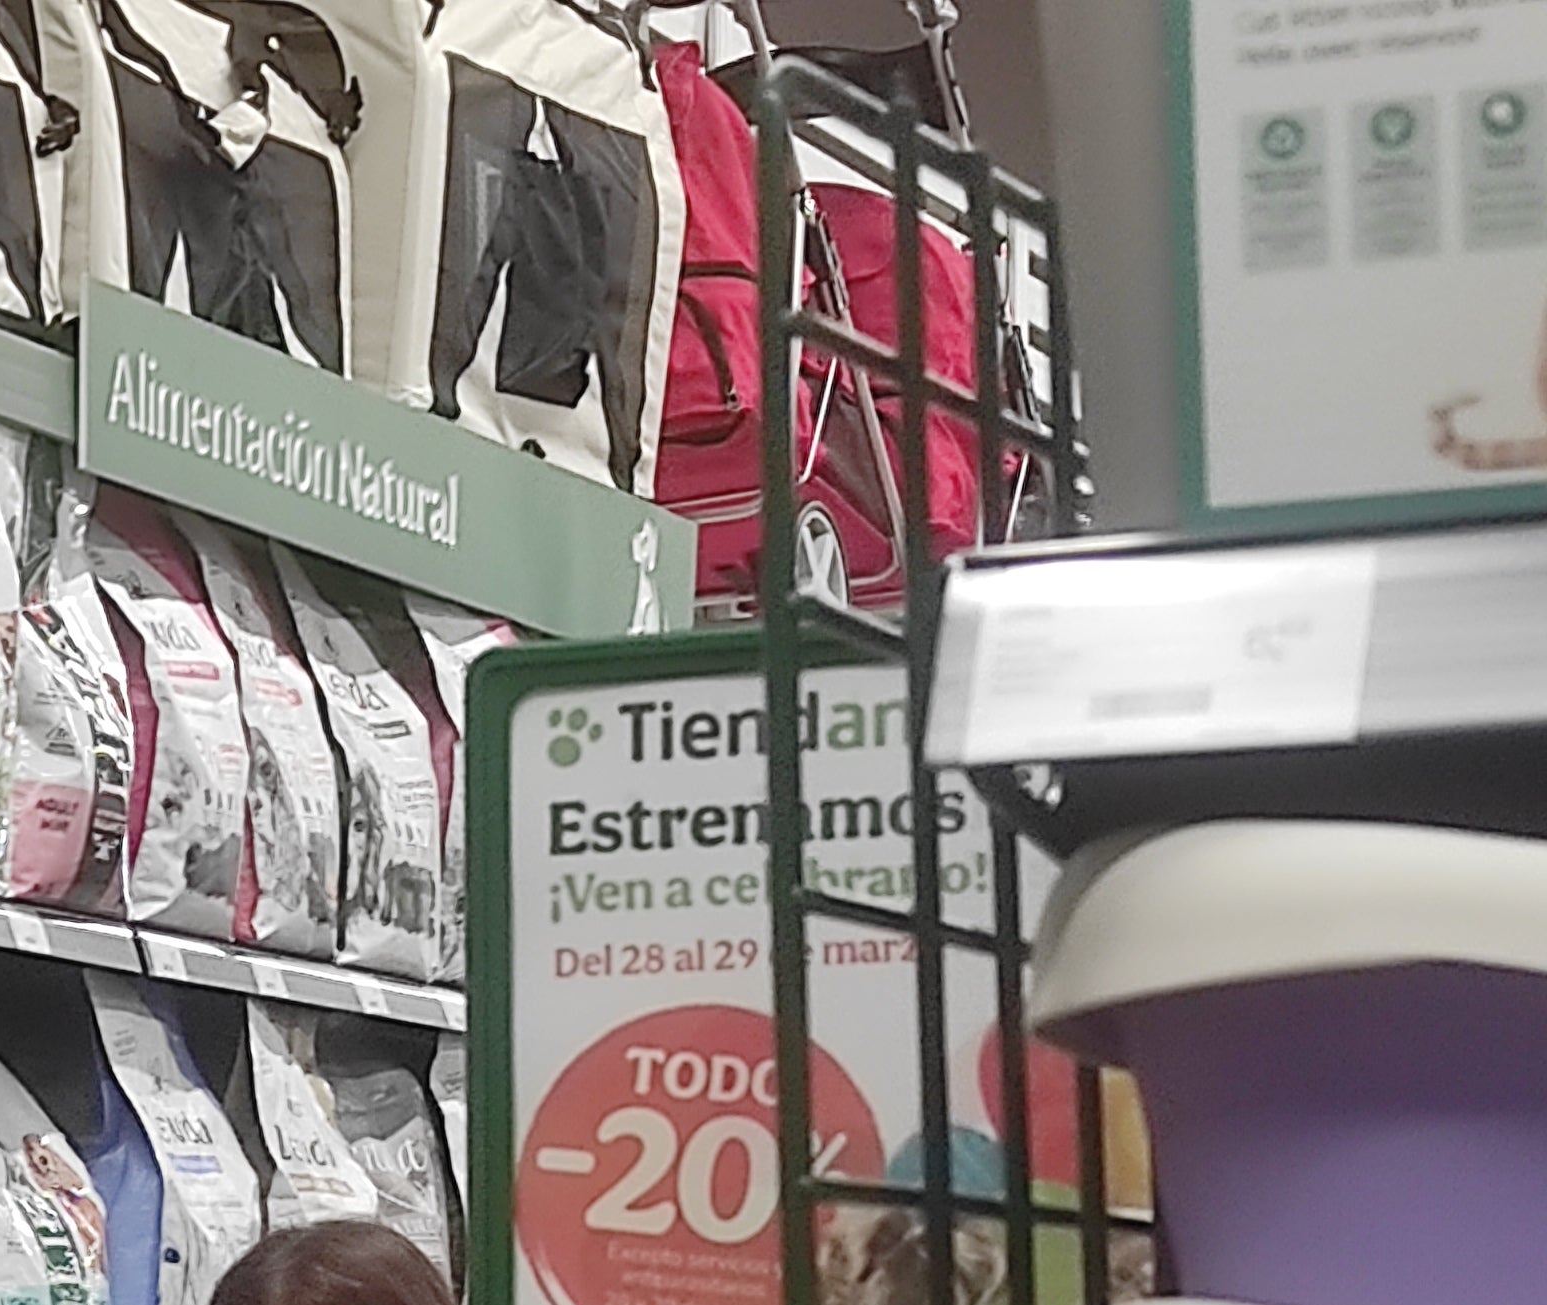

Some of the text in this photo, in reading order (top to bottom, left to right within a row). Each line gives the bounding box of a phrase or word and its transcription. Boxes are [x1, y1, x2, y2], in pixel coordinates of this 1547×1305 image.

[107, 350, 460, 549] Alimentación Natural
[549, 851, 989, 923] ¡Ven a cebrao!
[553, 941, 613, 980] Del
[621, 943, 665, 976] 28
[674, 939, 706, 972] al
[713, 938, 759, 973] 29
